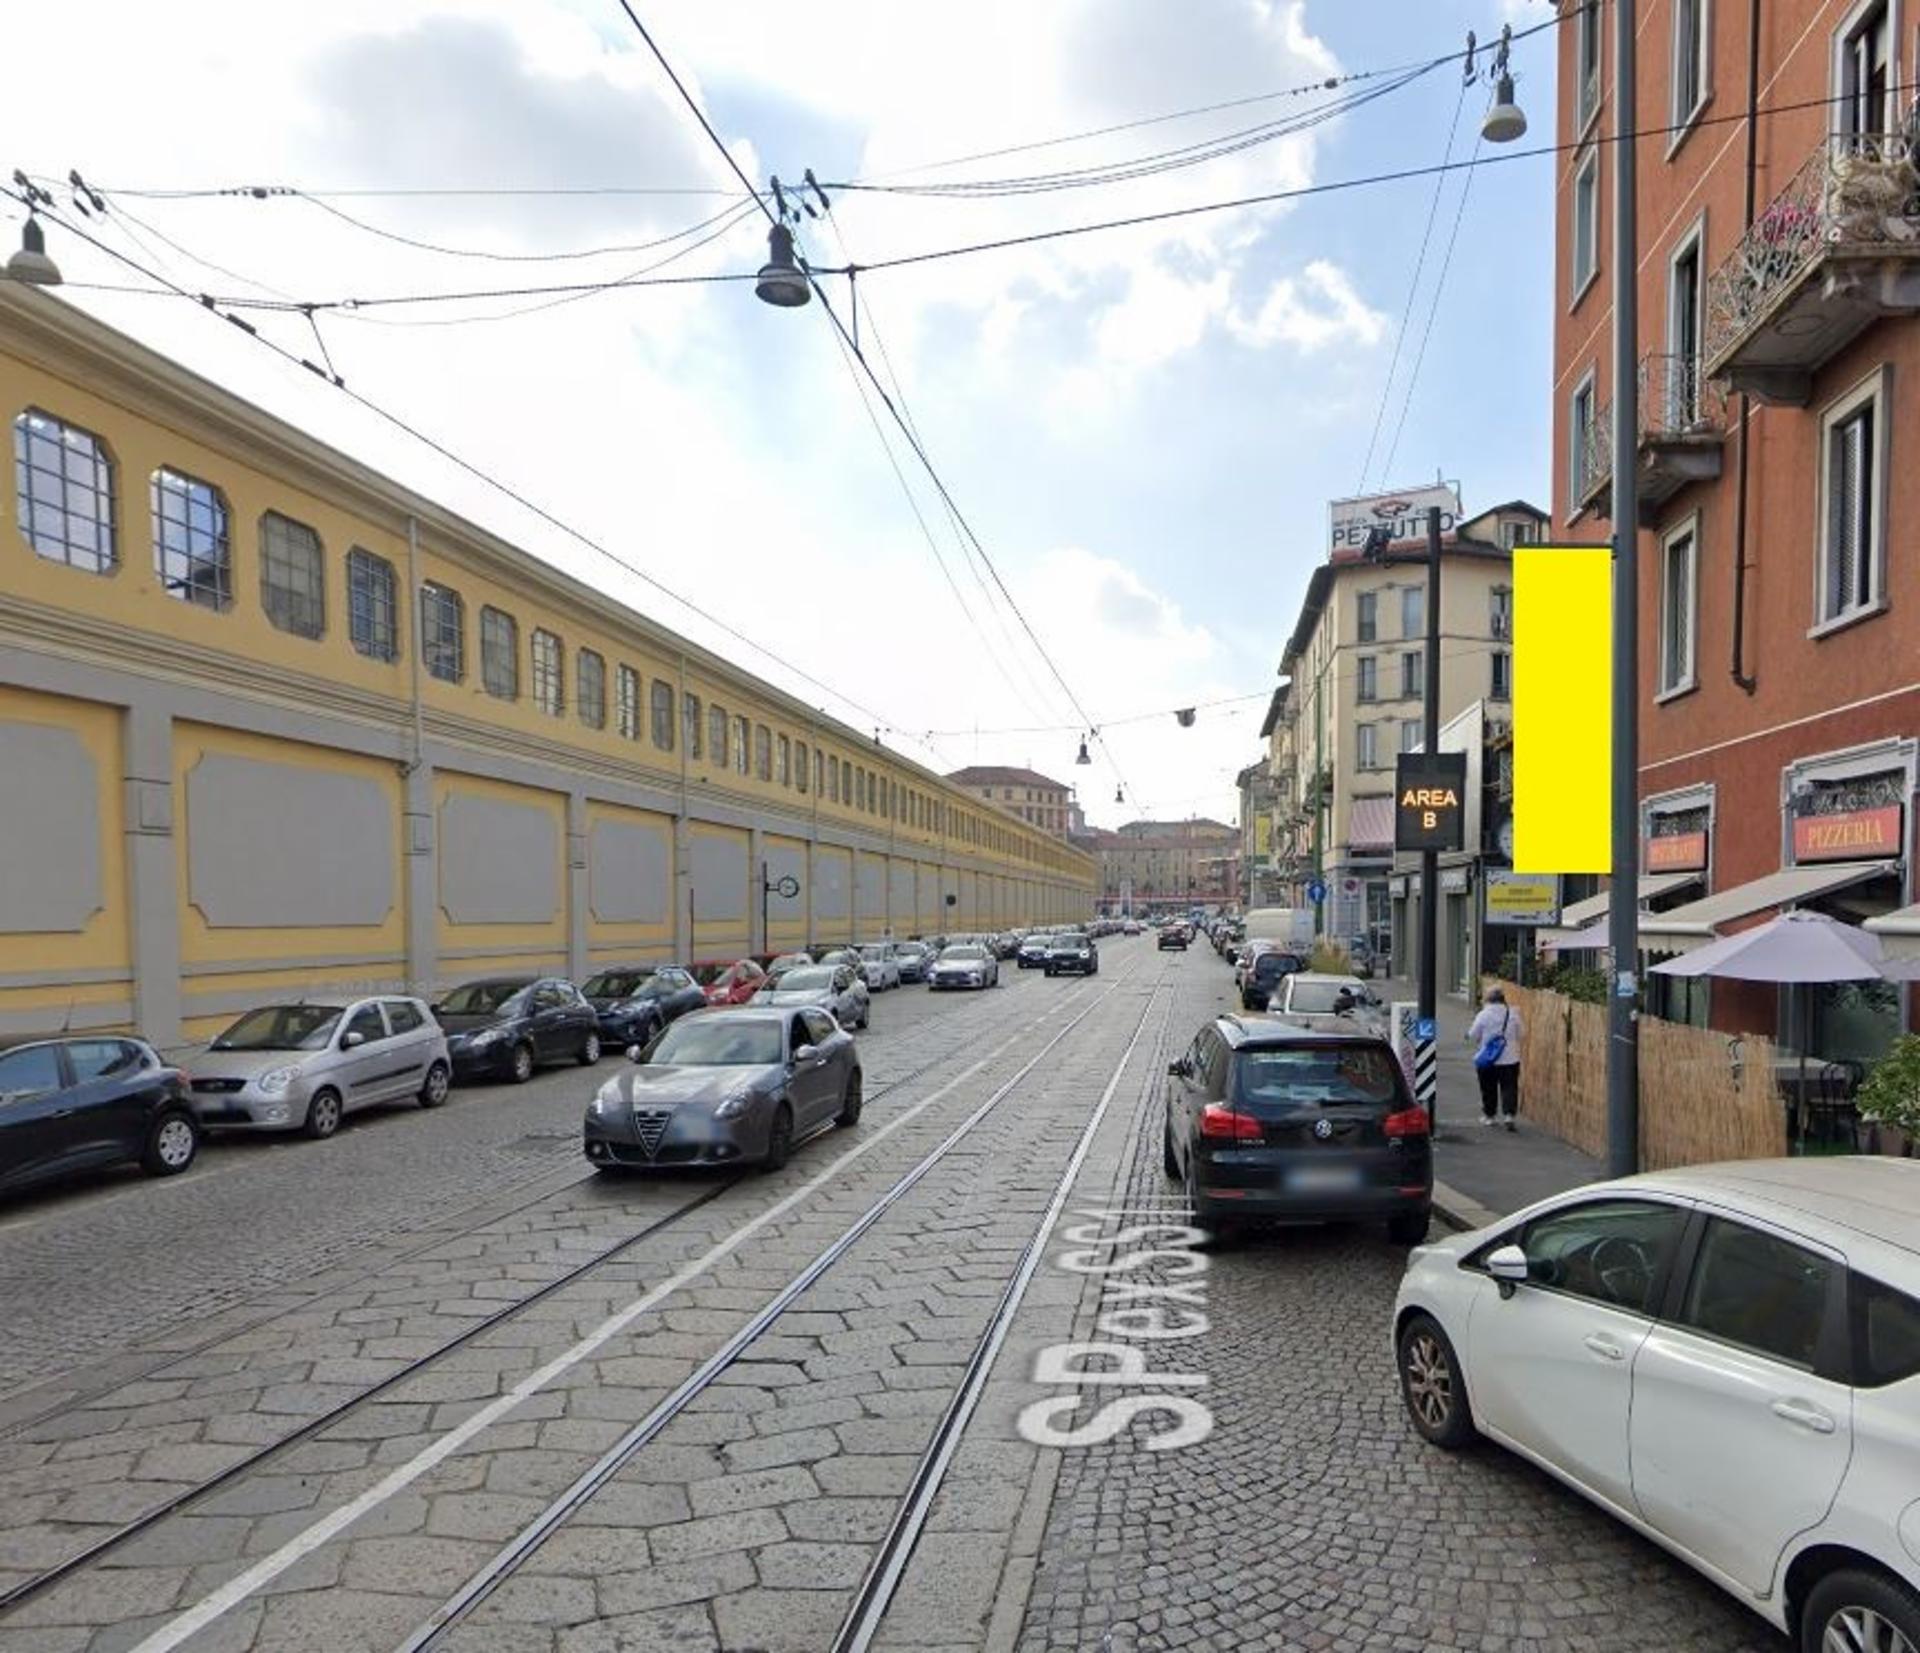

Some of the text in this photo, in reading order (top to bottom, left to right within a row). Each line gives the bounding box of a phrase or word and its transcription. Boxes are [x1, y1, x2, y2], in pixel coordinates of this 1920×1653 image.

[1401, 789, 1458, 807] AREA
[1423, 812, 1437, 828] B
[1808, 819, 1883, 849] PIZZERIA
